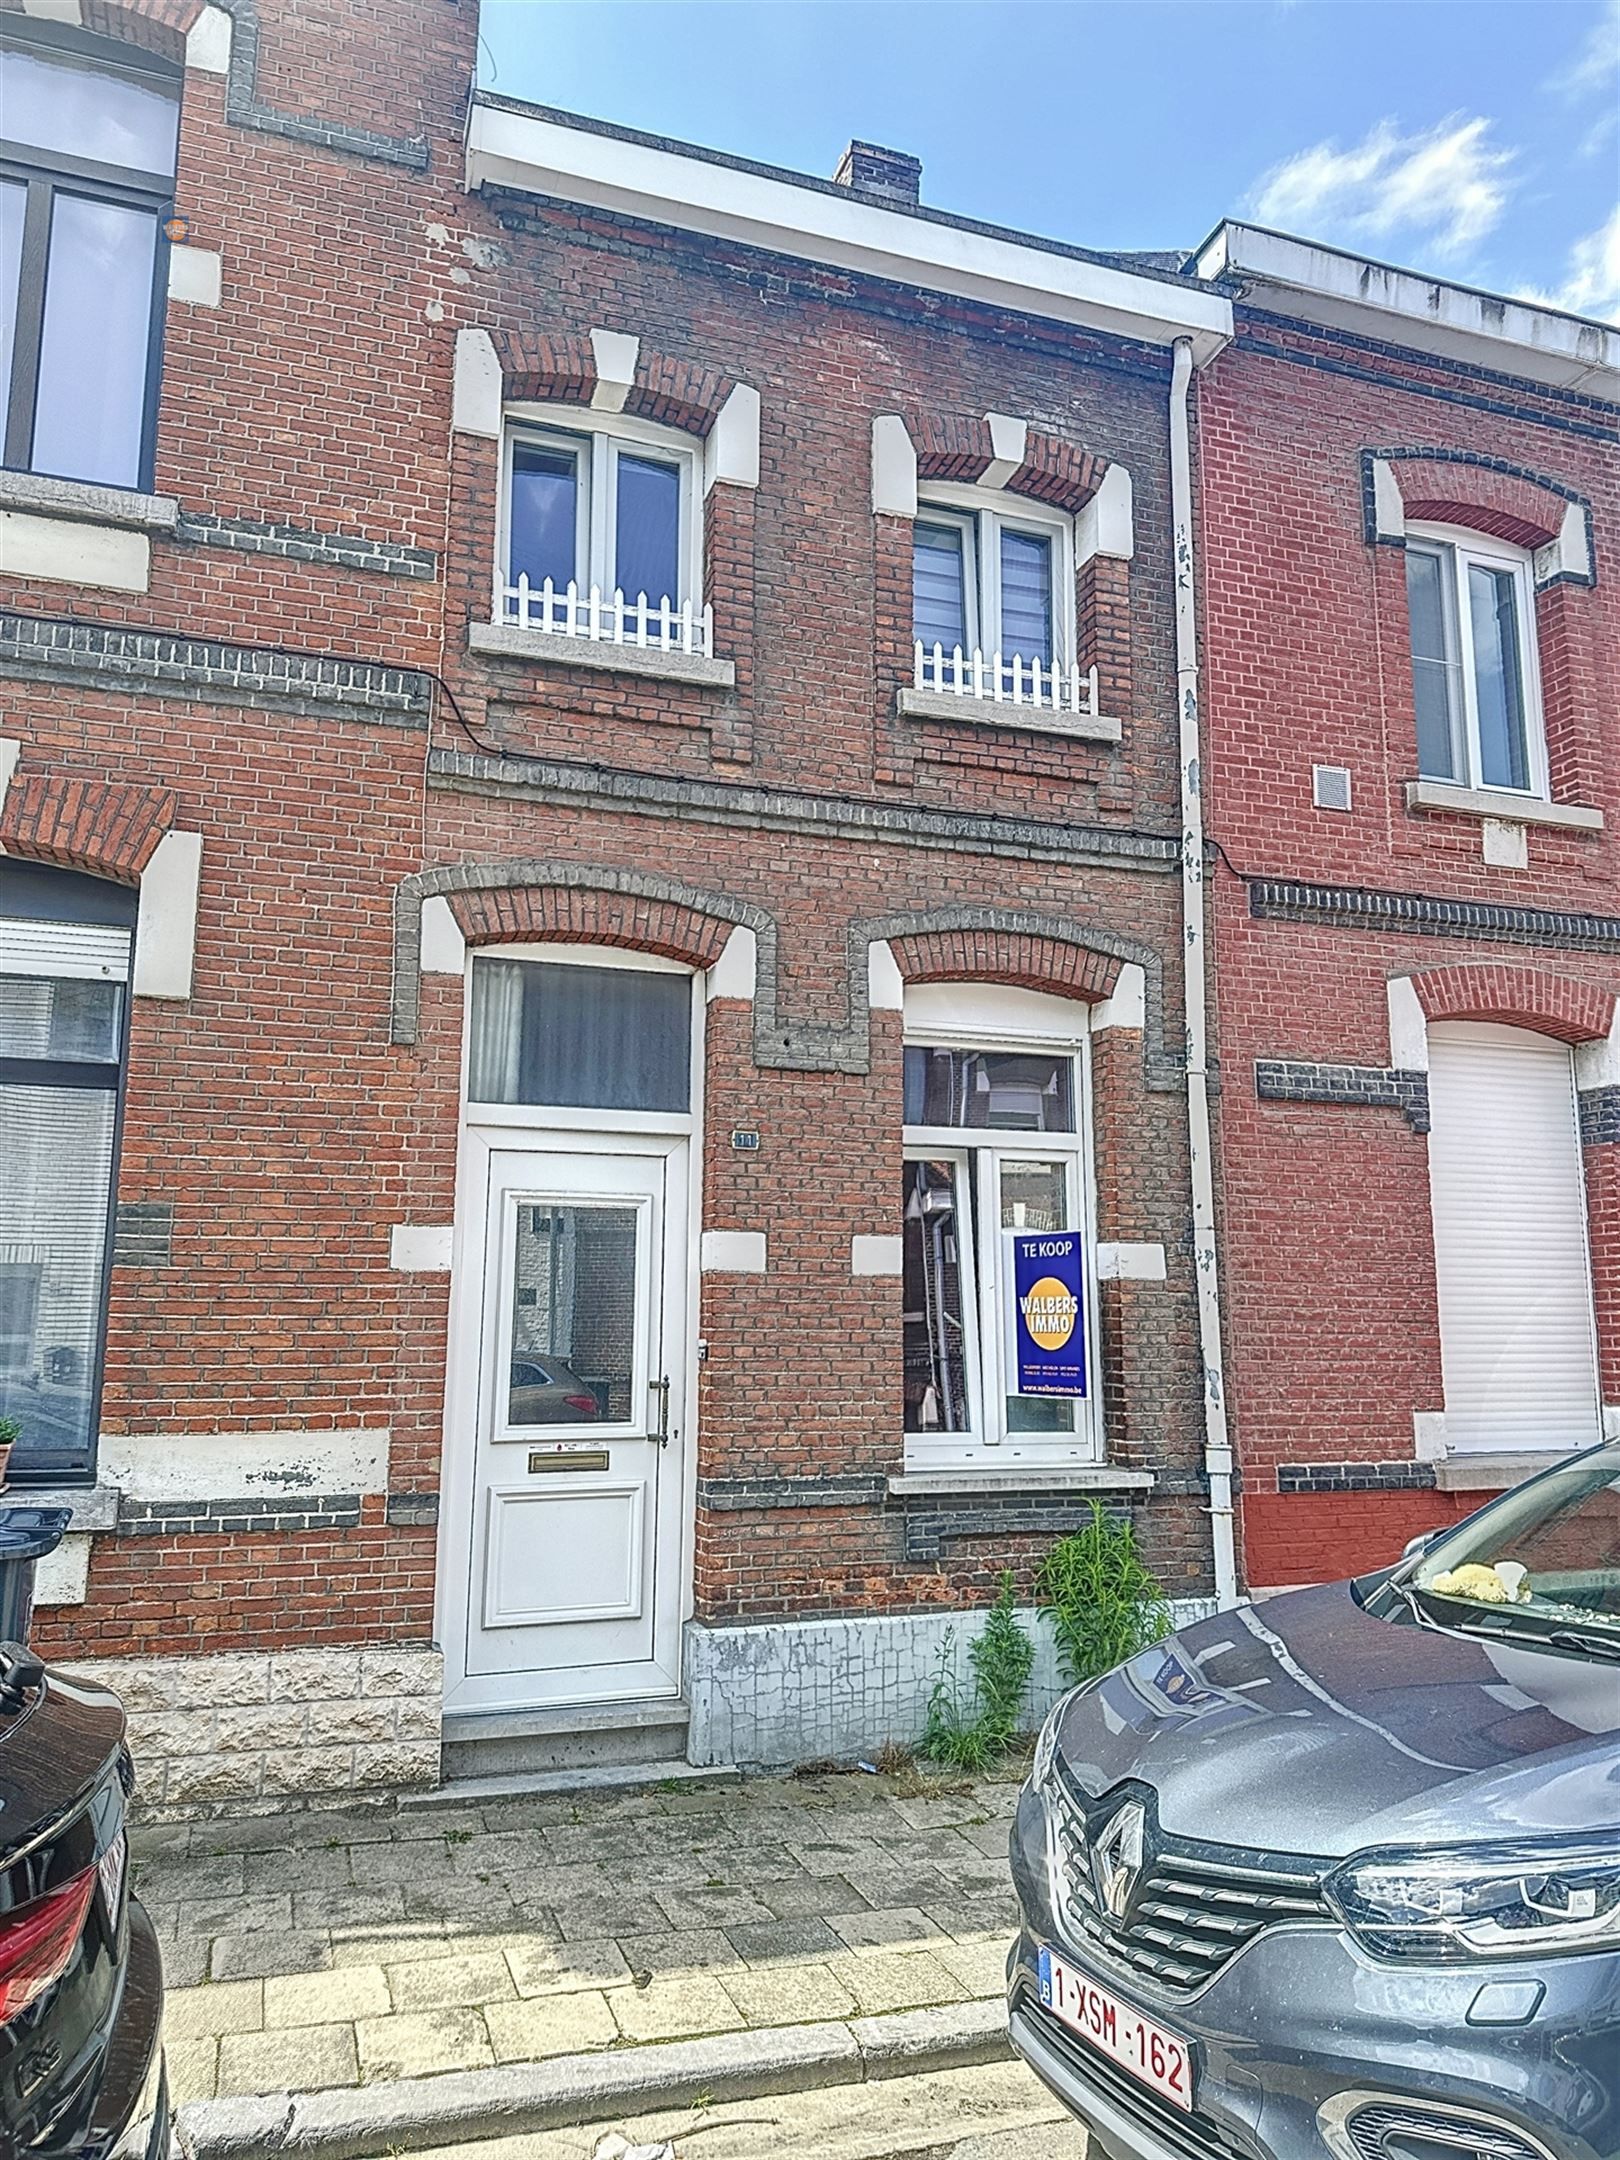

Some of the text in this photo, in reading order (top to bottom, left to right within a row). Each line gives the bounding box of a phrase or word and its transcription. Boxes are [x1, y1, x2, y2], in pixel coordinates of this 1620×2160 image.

[1022, 1240, 1073, 1258] TE KOOP
[1019, 1296, 1079, 1314] WALBERS
[1030, 1315, 1070, 1333] IMMO
[1042, 1979, 1051, 2000] B
